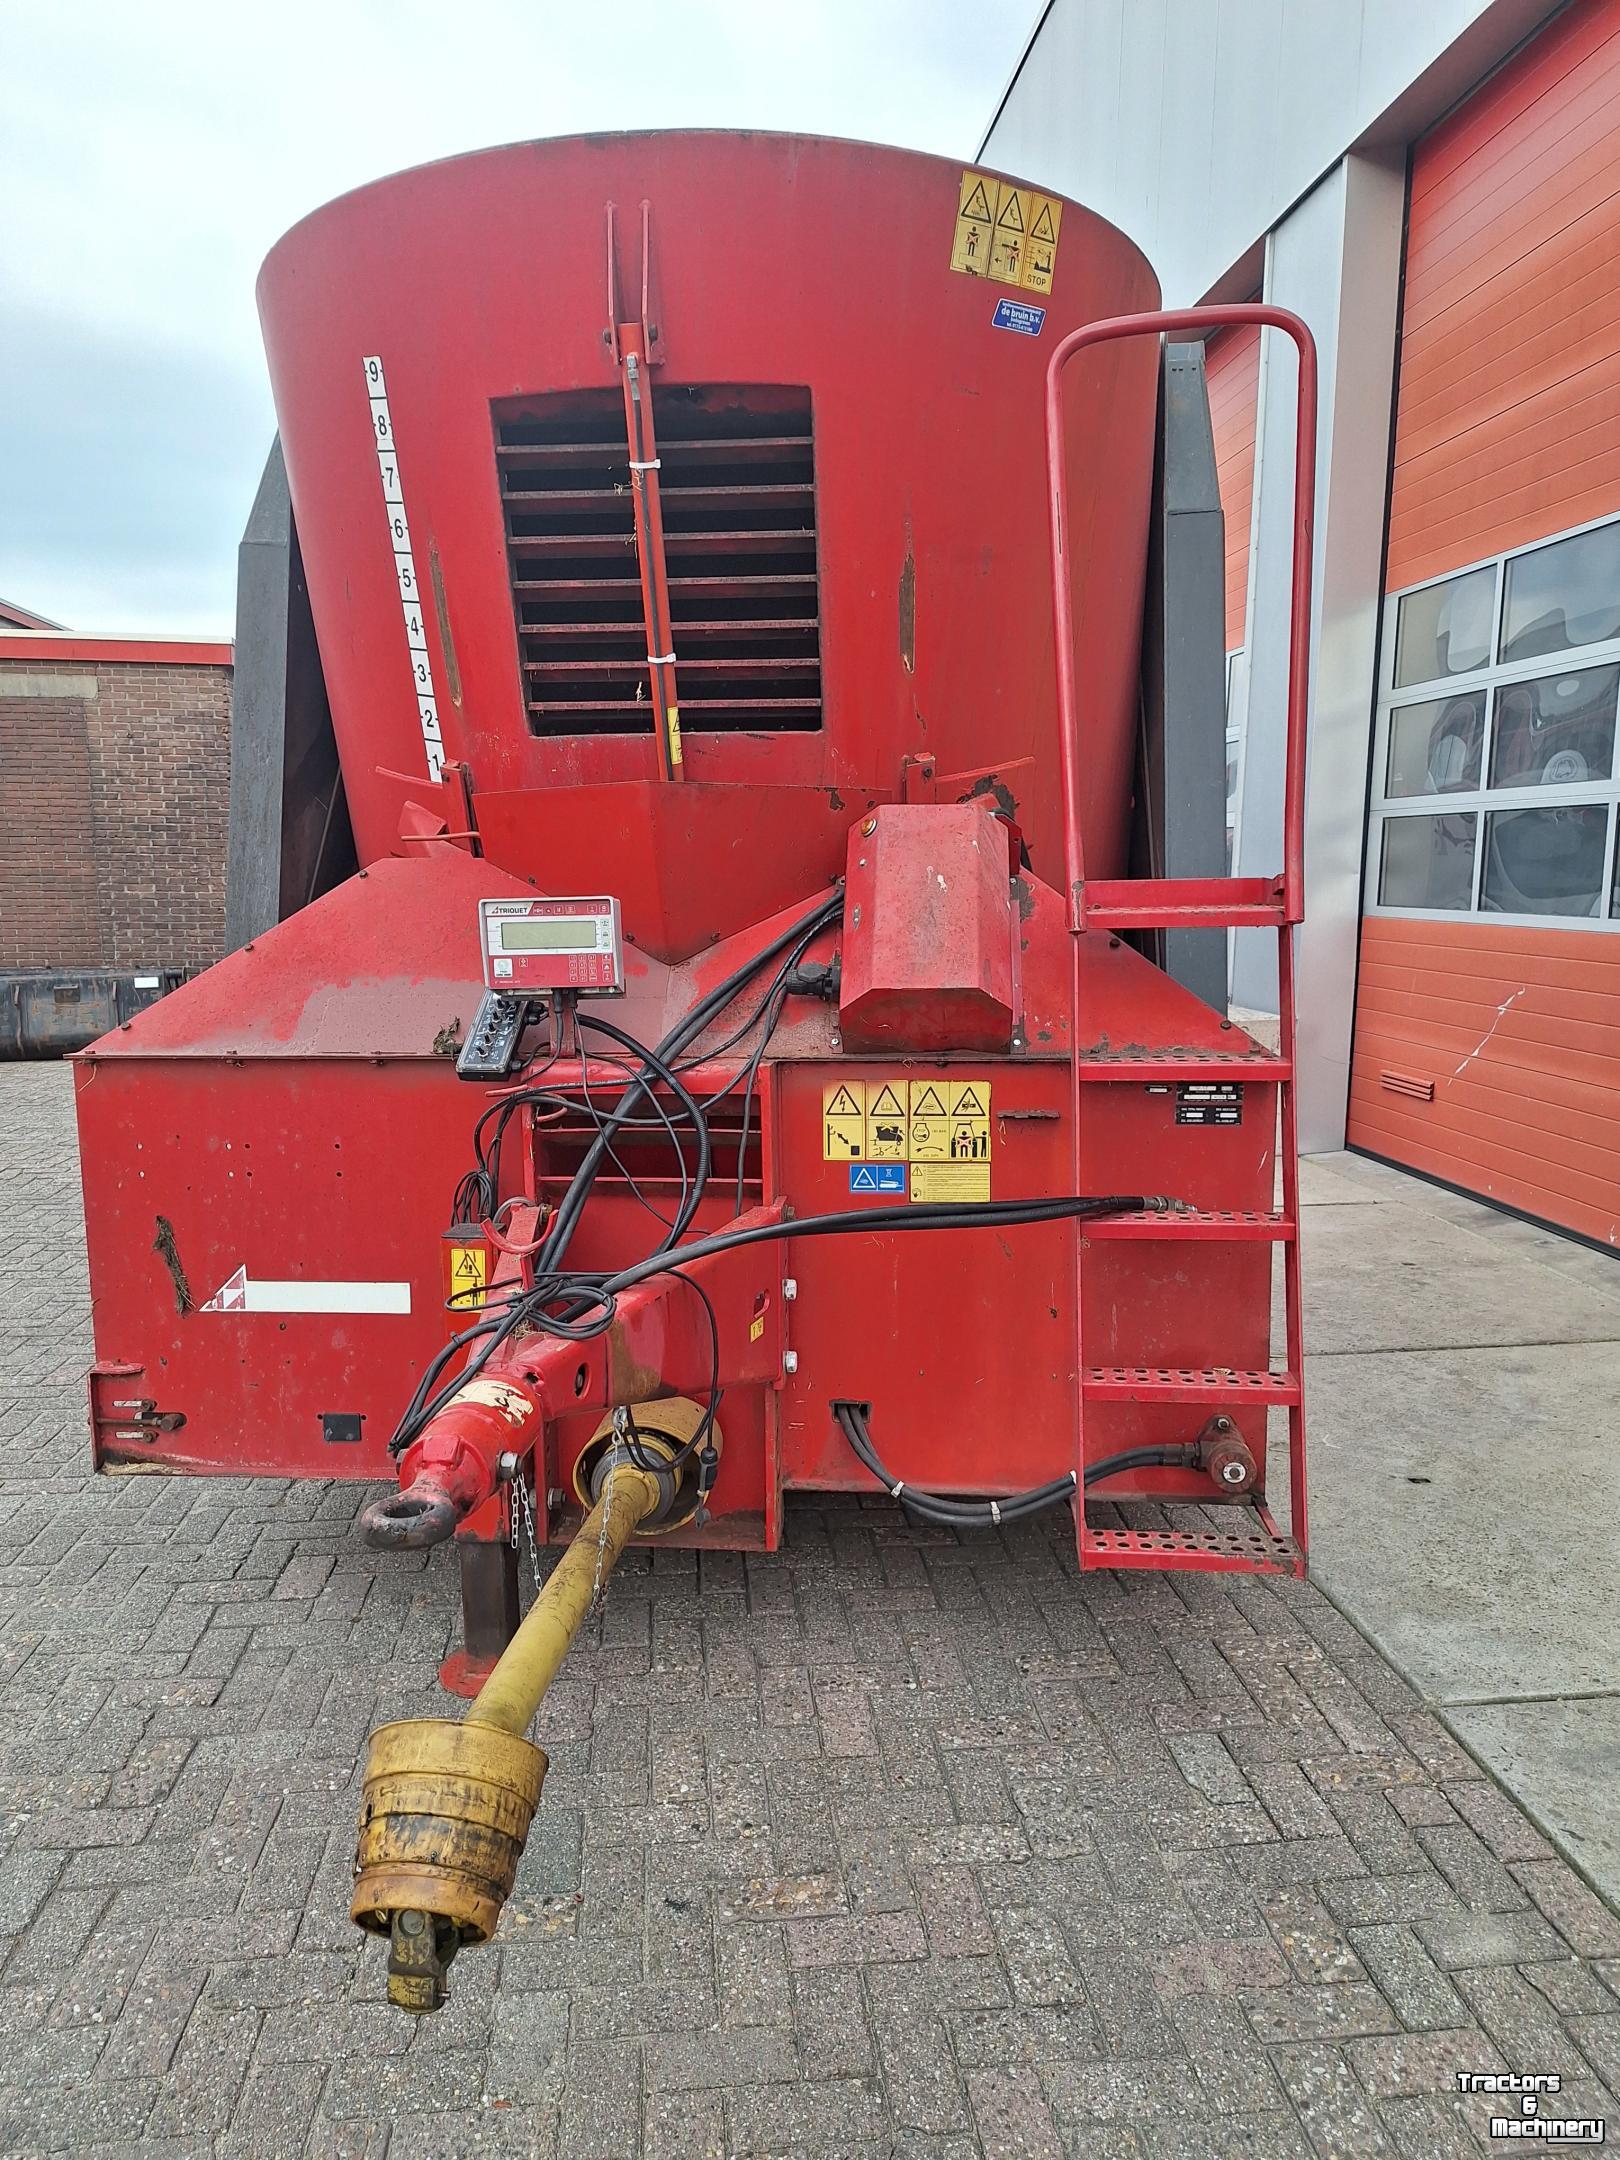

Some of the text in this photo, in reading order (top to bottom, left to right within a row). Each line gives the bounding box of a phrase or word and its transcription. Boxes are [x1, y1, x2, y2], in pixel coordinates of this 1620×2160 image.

[1027, 274, 1046, 286] STOP
[1001, 306, 1010, 316] de
[1010, 308, 1029, 320] bruin
[1029, 313, 1041, 323] b.v.
[369, 360, 379, 382] 9
[377, 414, 387, 436] 8
[385, 466, 394, 488] 7
[394, 518, 404, 539] 6
[402, 568, 412, 588] 5
[410, 616, 419, 636] 4
[417, 663, 427, 683] 3
[424, 709, 435, 728] 2
[432, 753, 440, 772] 1
